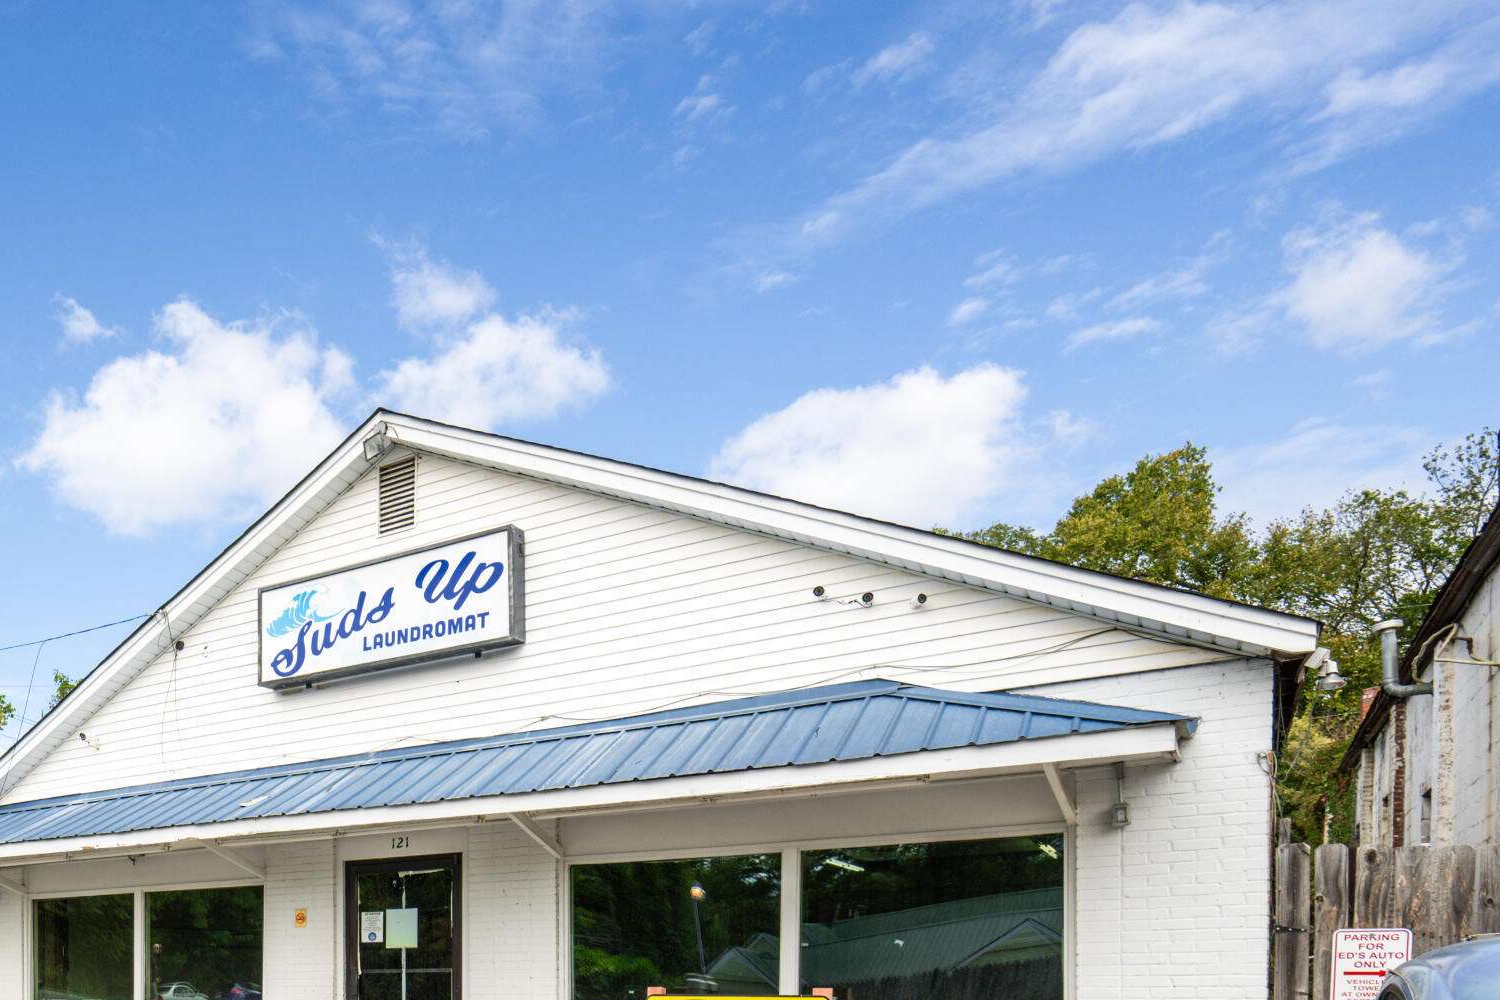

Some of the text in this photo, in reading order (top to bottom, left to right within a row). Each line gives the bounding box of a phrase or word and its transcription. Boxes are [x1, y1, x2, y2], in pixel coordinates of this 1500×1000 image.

[271, 551, 505, 677] Suds Up
[362, 611, 490, 652] LAUNDROMAT
[391, 836, 409, 849] 121
[1344, 933, 1400, 941] PARKING
[1338, 952, 1405, 960] ED'S AUTO
[1354, 961, 1387, 969] ONLY
